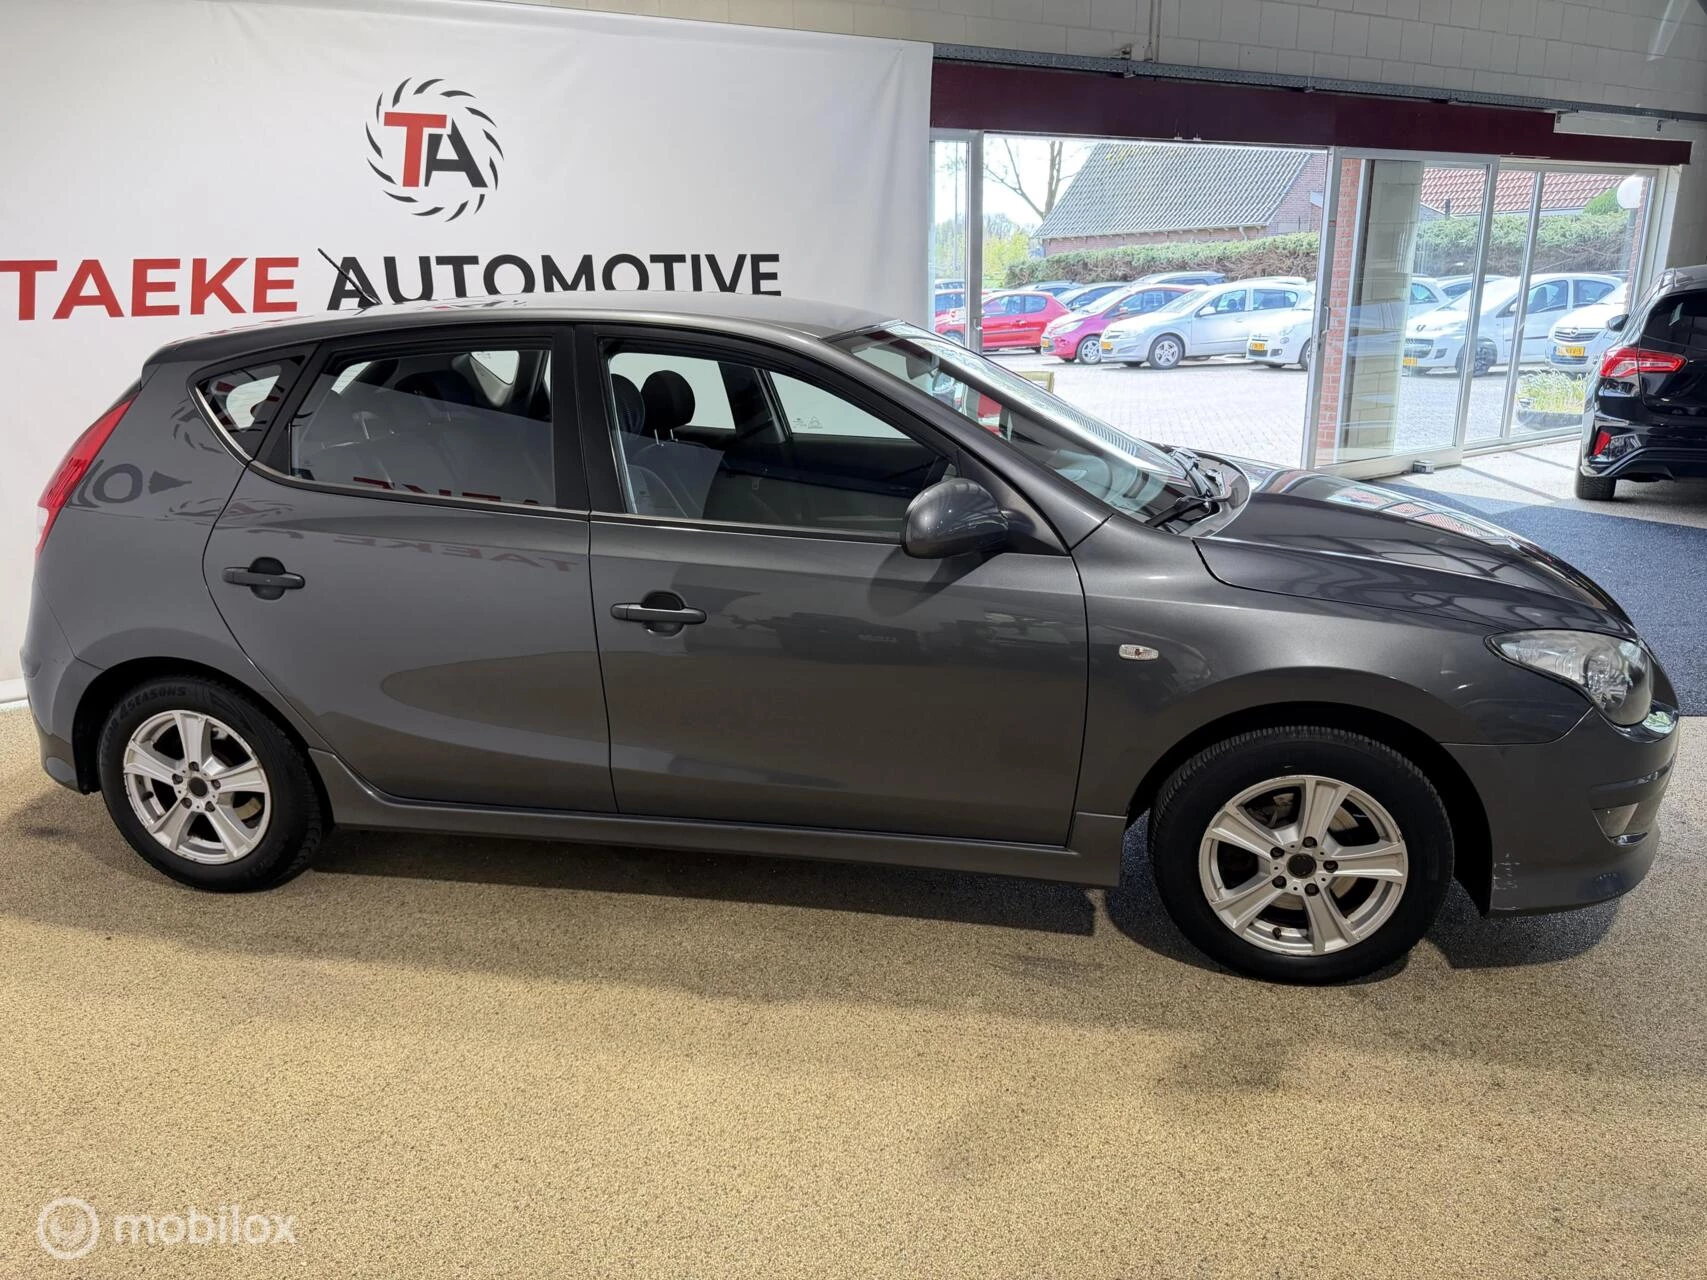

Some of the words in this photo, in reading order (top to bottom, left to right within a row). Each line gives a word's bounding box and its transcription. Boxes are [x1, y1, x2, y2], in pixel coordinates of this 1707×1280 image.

[384, 112, 488, 188] TA
[0, 257, 299, 320] TAEKE
[327, 253, 781, 310] AUTOMOTIVE
